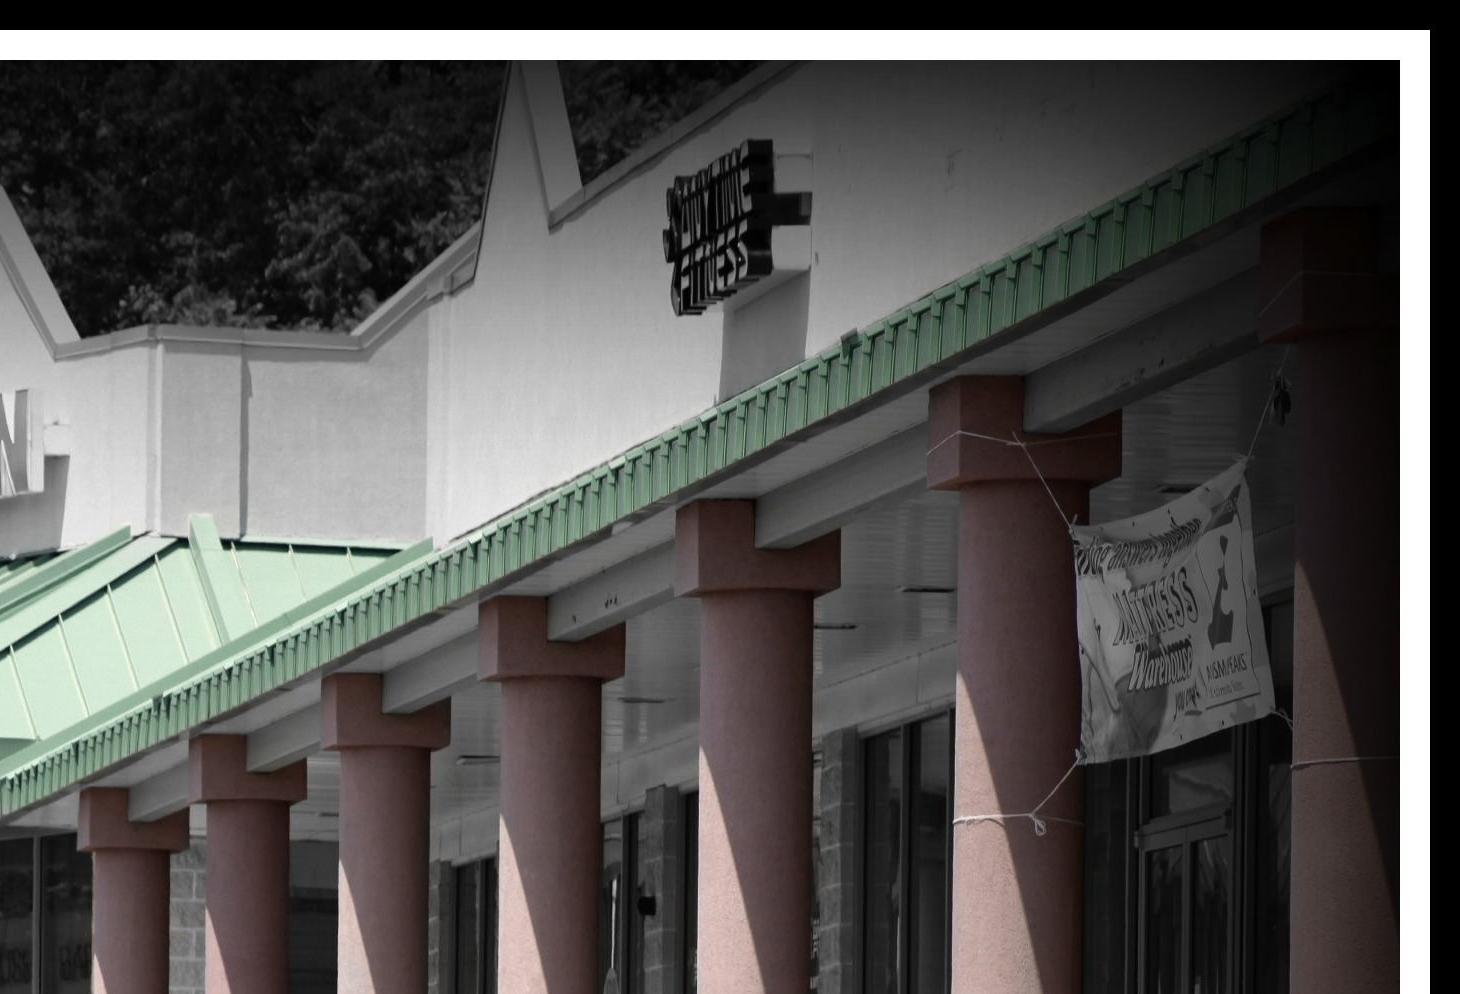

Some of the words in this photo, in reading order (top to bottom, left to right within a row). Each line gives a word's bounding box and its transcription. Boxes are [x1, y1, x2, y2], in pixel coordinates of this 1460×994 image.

[679, 139, 754, 252] ANYTIME
[679, 216, 749, 317] FITNESS
[1127, 636, 1195, 692] Warehouse
